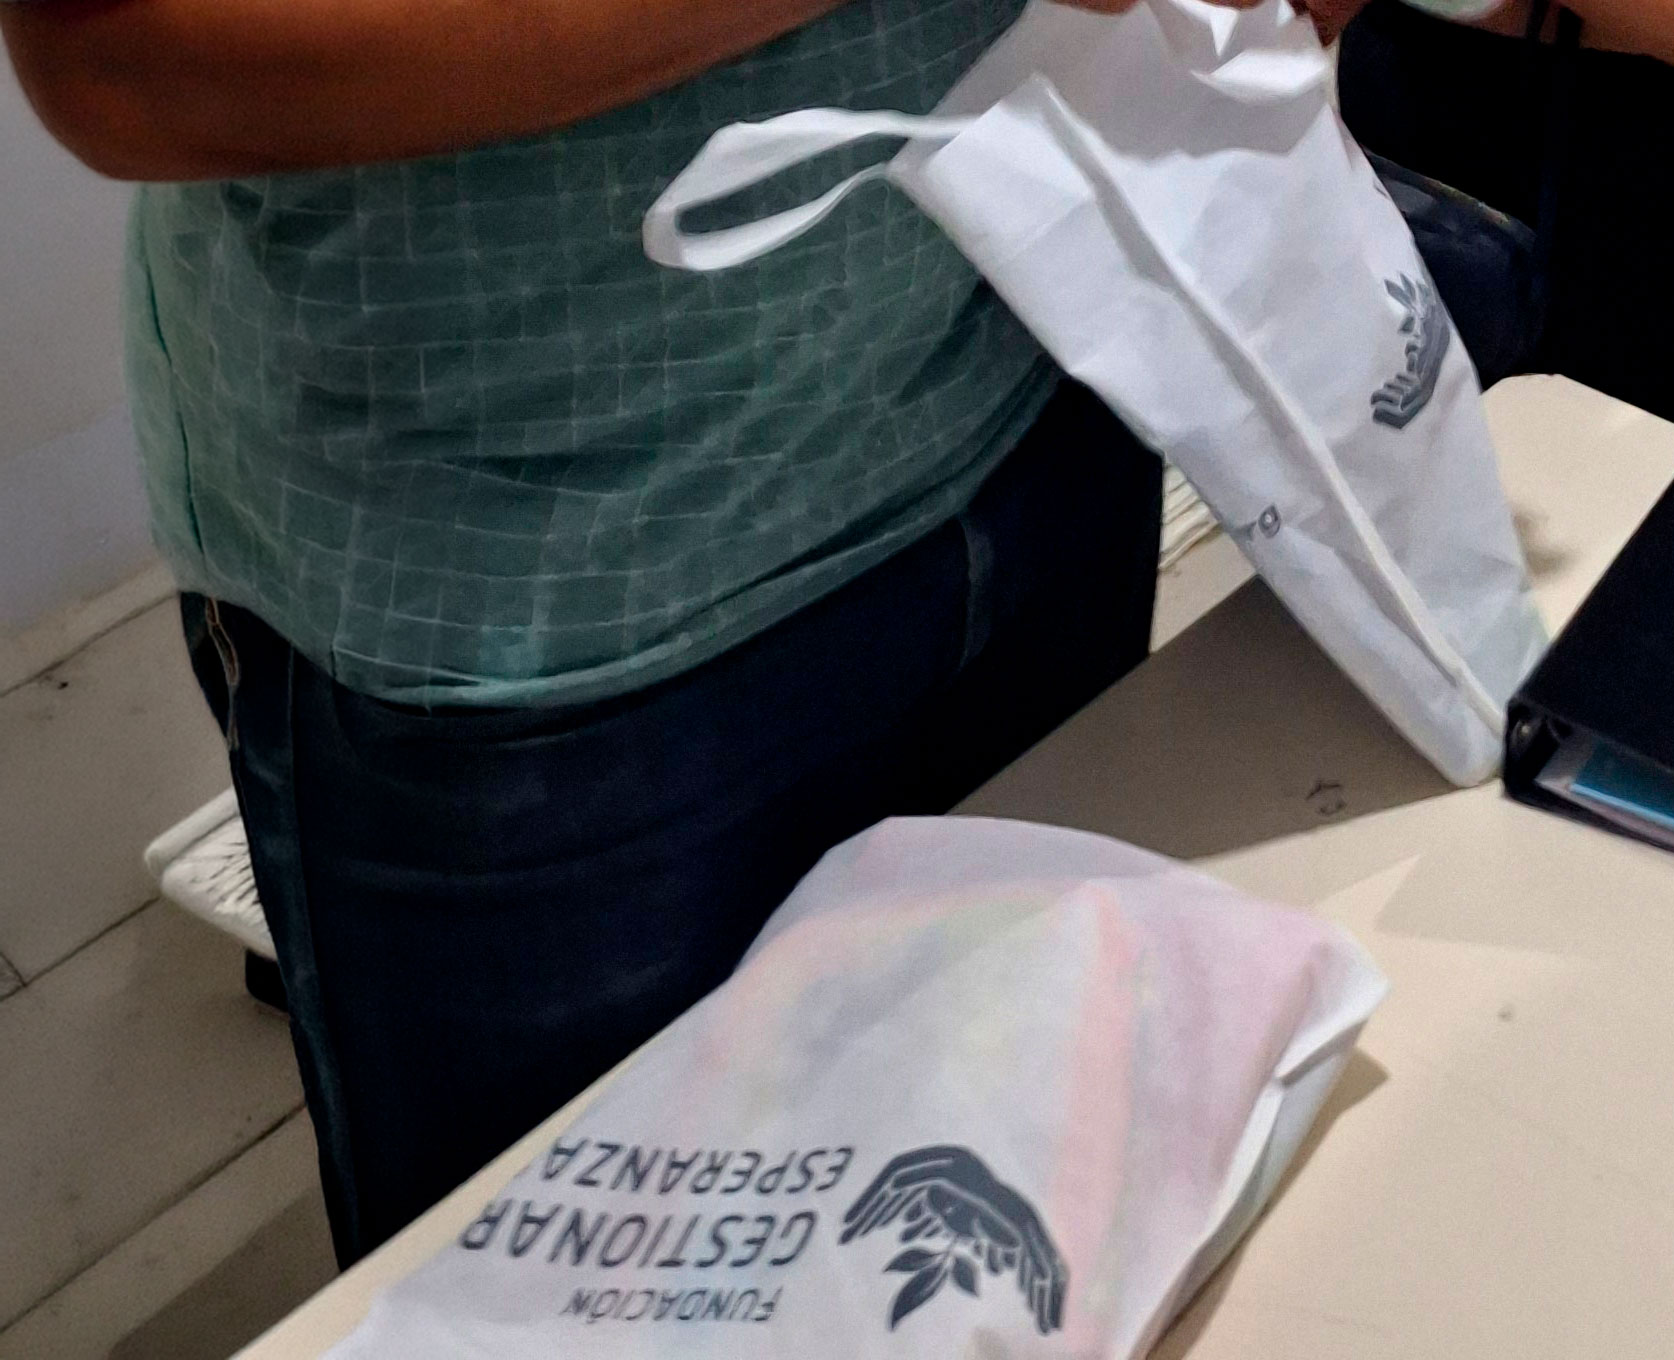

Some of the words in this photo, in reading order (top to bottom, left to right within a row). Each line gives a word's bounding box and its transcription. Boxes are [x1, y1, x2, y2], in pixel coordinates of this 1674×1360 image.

[543, 1135, 855, 1195] ESPERANZA
[460, 1197, 818, 1270] GESTIONAR
[559, 1284, 783, 1325] FUNDACIÓN
